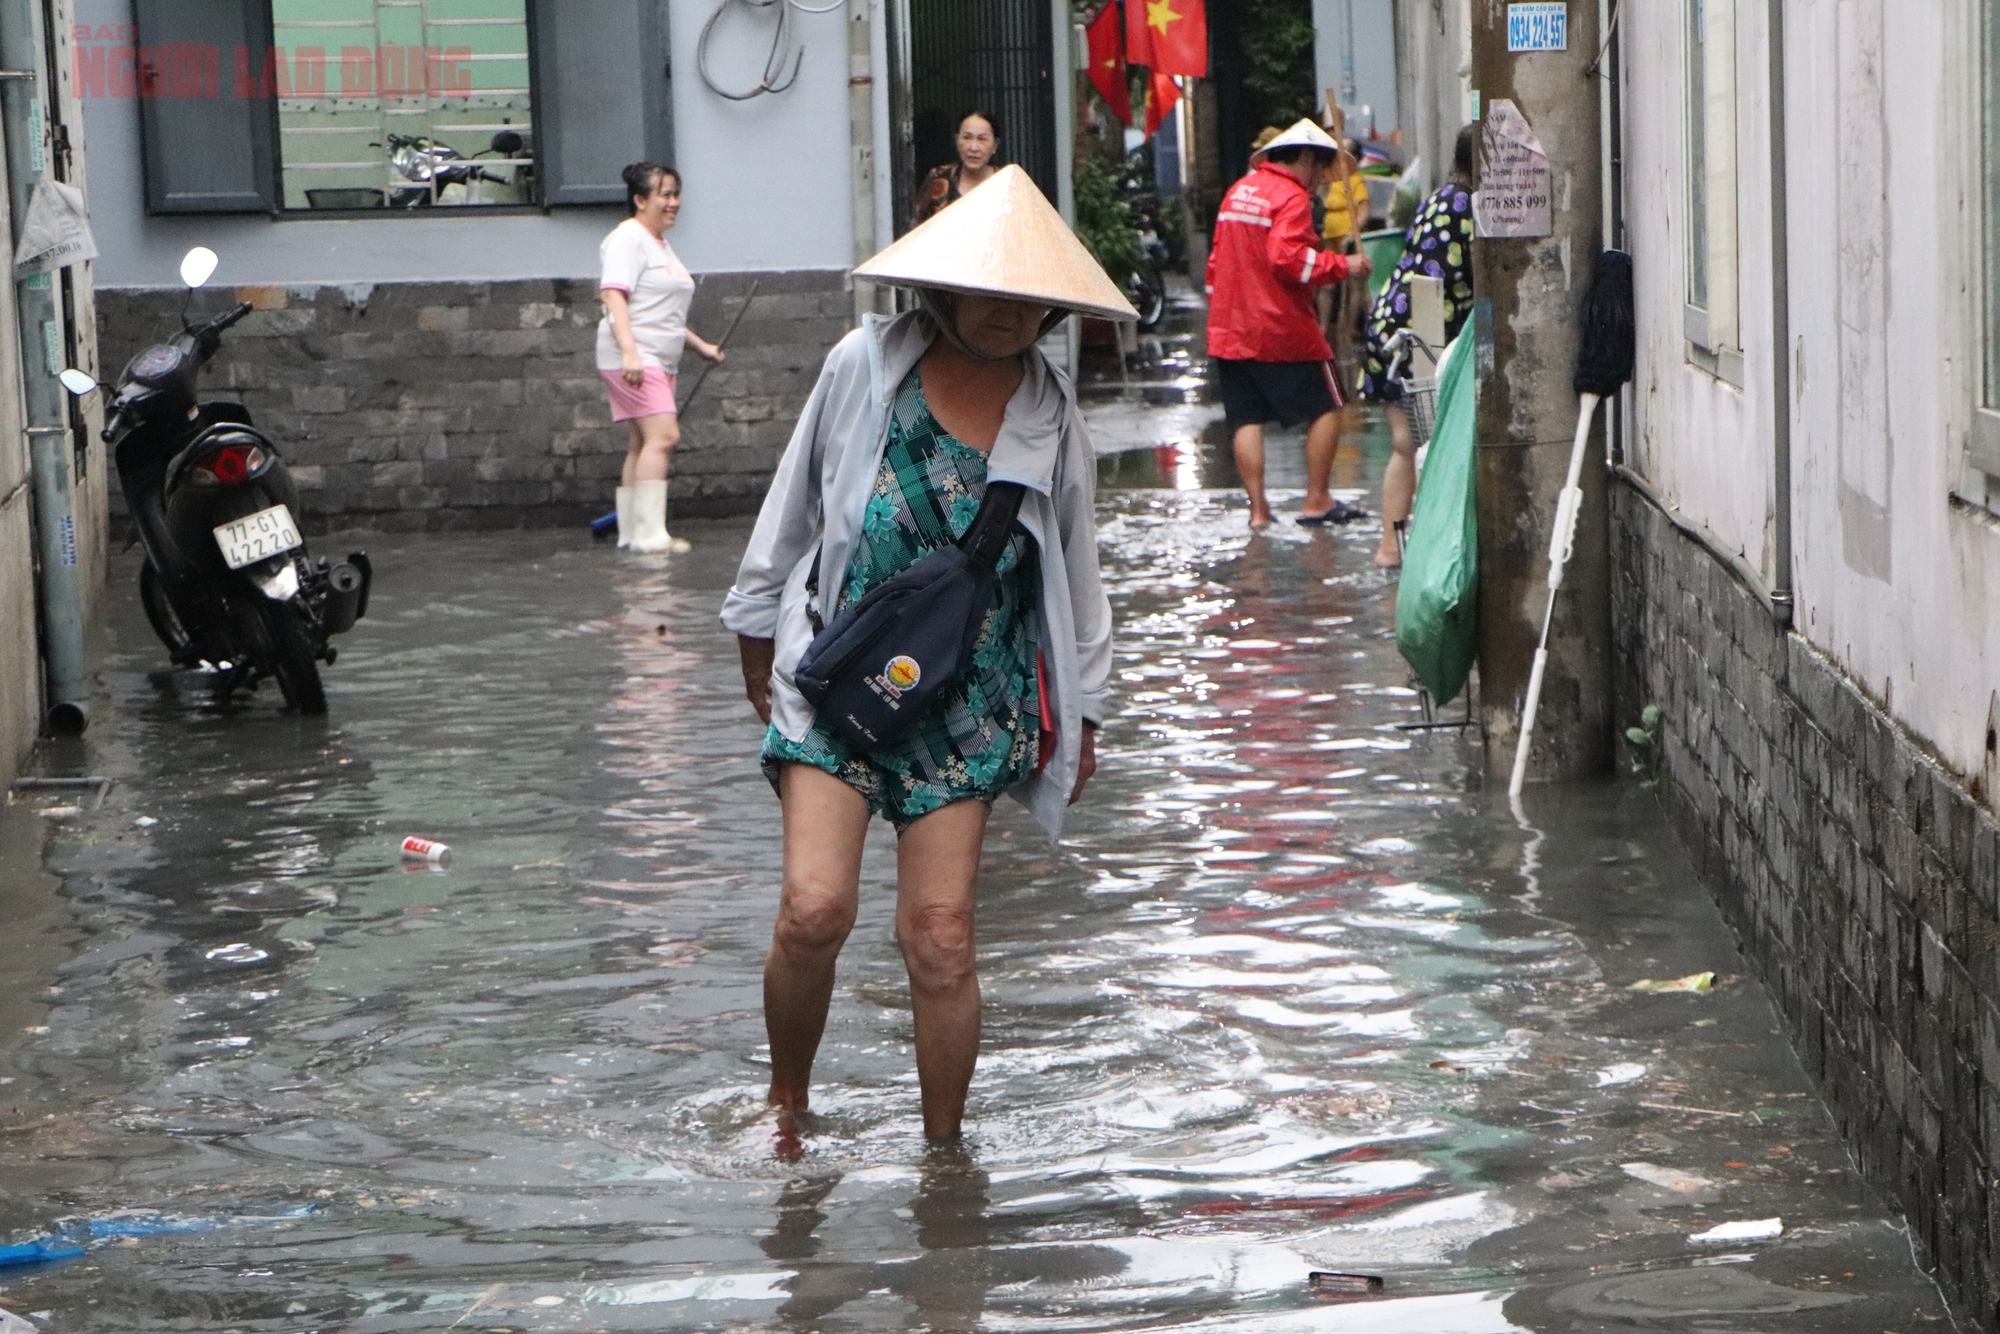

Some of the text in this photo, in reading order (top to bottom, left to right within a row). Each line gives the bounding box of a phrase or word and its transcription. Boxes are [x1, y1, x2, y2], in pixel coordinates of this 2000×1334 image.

[1510, 14, 1565, 48] 0934.224.557
[1503, 195, 1523, 210] 885
[1526, 194, 1547, 209] 099
[226, 513, 279, 543] 77-G1
[230, 528, 295, 566] 422.20
